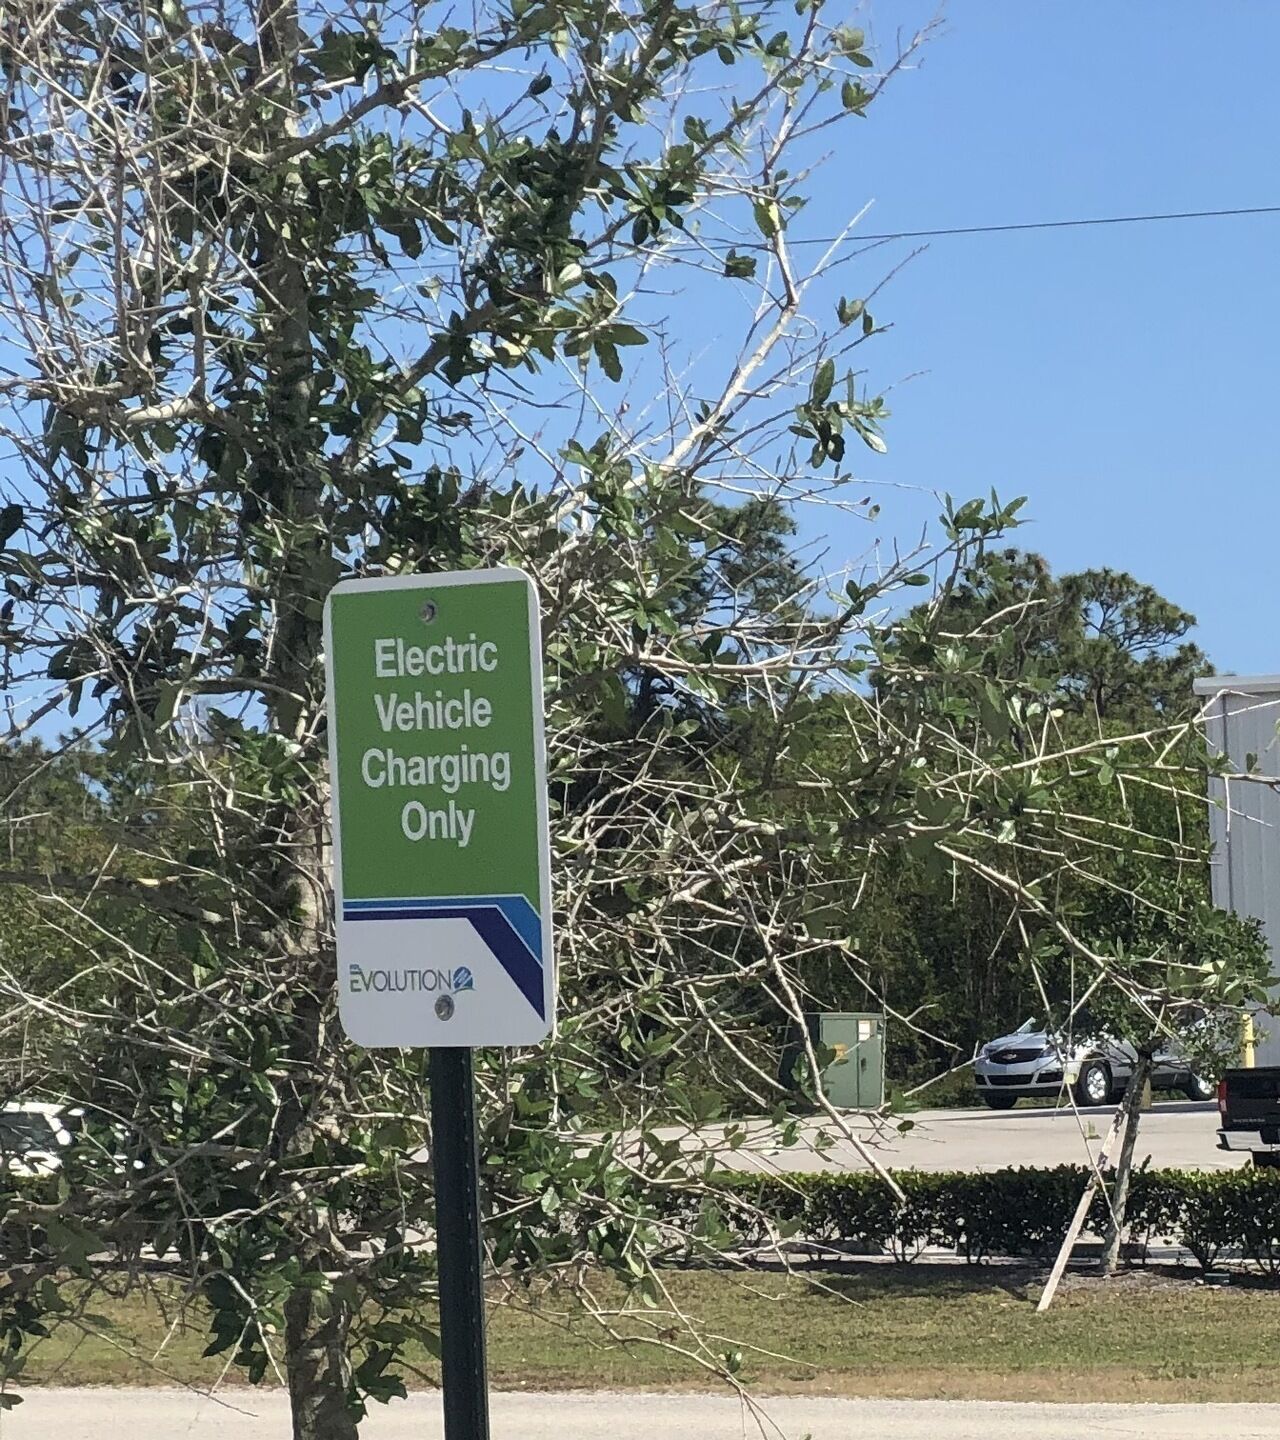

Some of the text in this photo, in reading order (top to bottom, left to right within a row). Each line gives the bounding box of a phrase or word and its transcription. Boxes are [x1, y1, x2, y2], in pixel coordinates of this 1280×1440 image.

[374, 633, 498, 678] Electric
[374, 689, 492, 732] Vehicle
[361, 744, 511, 795] Charging
[401, 800, 475, 848] Only
[349, 966, 452, 992] EVOLUTION
